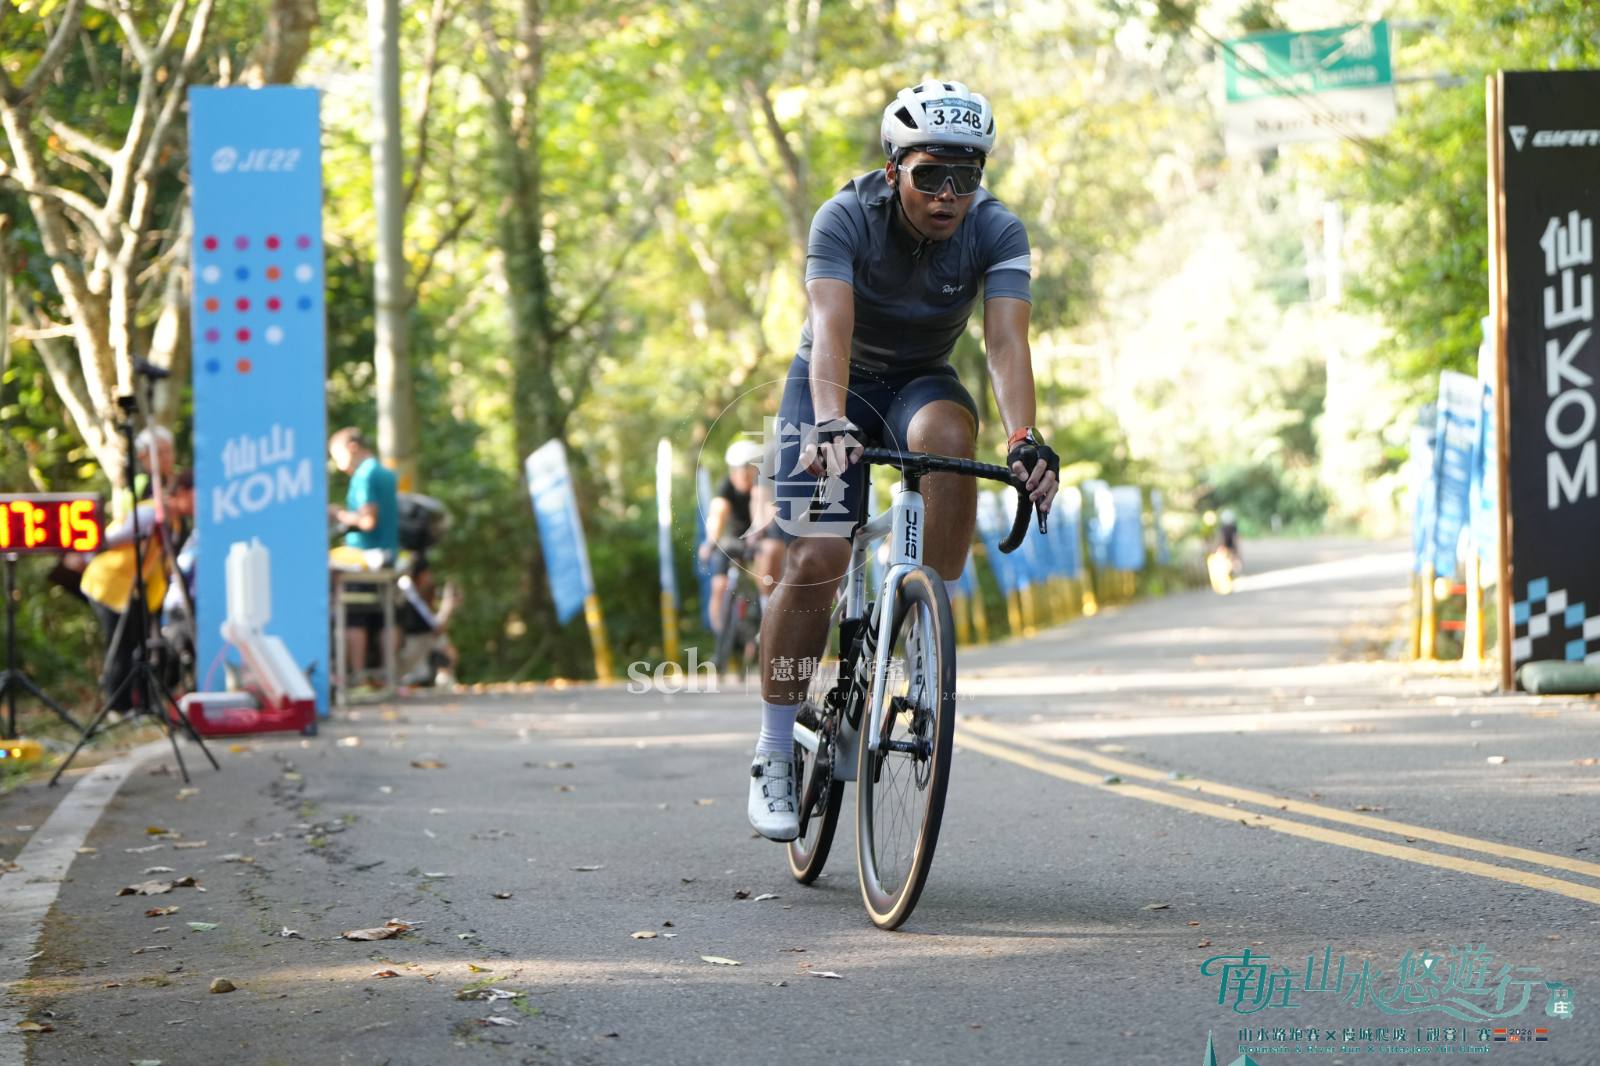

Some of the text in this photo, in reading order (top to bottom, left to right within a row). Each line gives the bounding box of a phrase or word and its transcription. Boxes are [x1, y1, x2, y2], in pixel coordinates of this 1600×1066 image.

[1531, 129, 1600, 147] GIAN
[221, 423, 295, 480] 仙山
[212, 458, 313, 524] KOM
